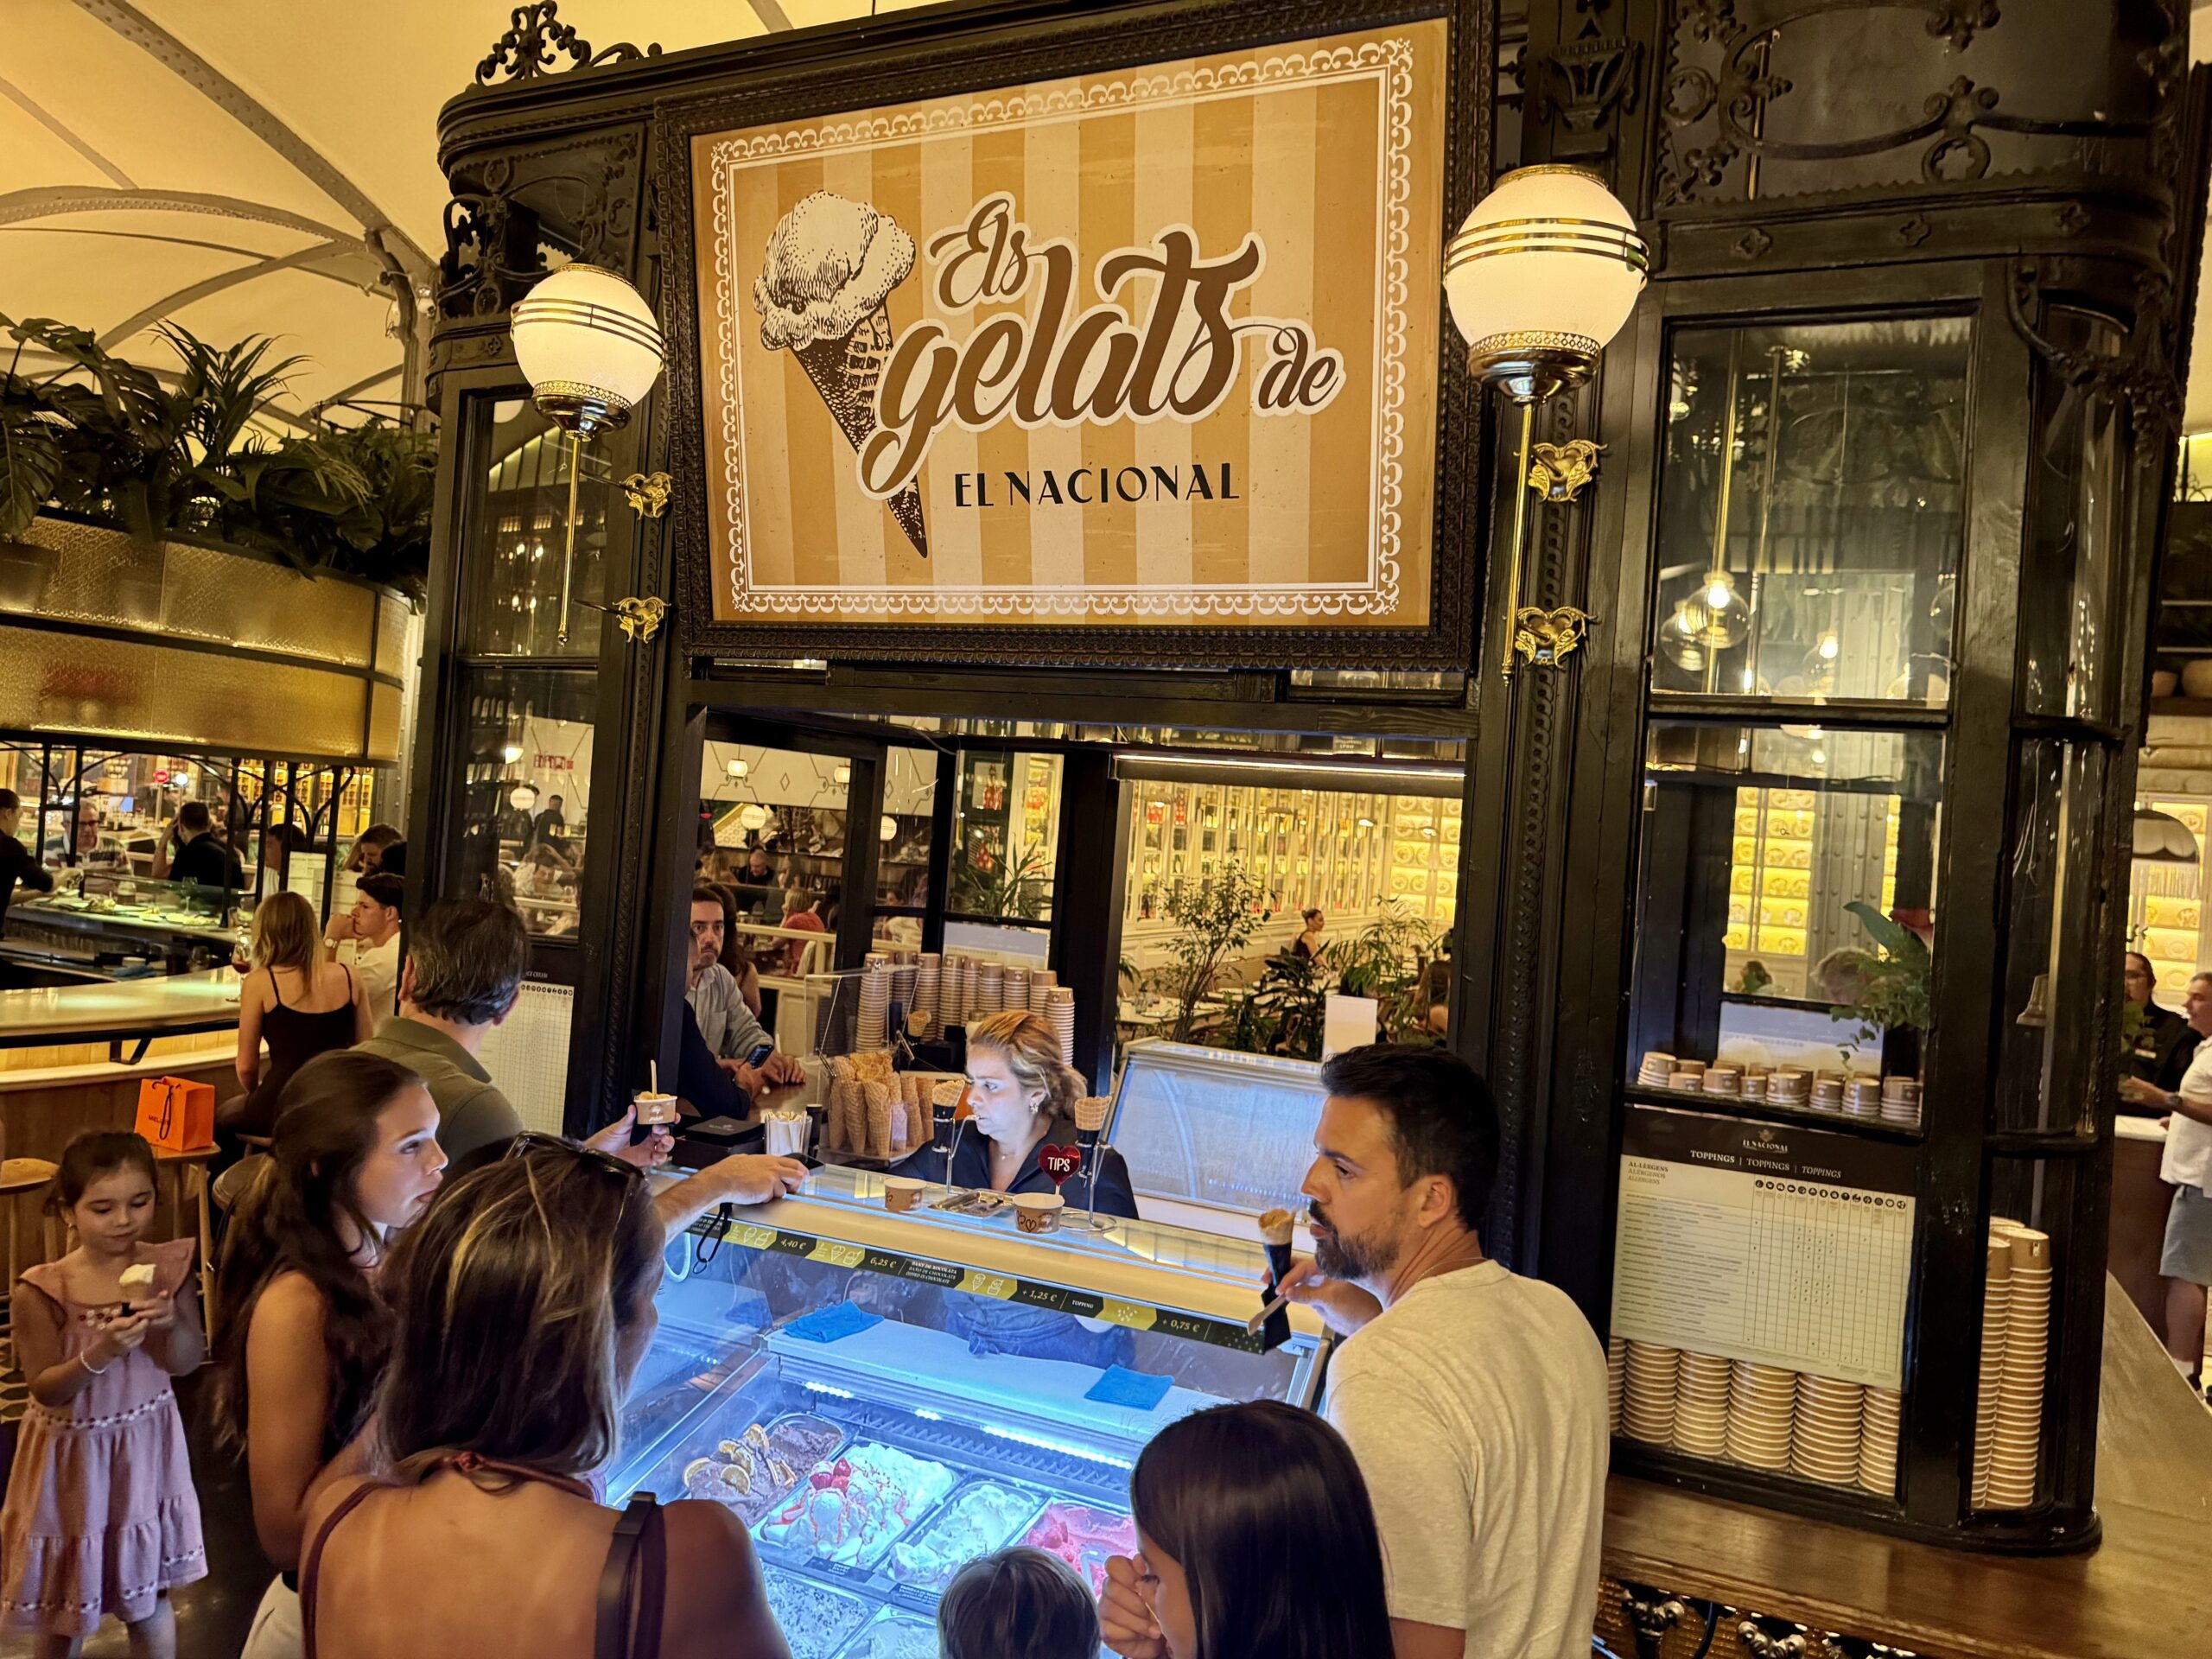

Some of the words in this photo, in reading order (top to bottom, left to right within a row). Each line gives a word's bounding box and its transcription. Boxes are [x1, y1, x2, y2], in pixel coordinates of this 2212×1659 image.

[930, 199, 1032, 309] Els
[861, 231, 1261, 493] gelats
[1259, 327, 1339, 409] de
[955, 473, 994, 508] EL
[1006, 461, 1240, 505] NACIONAL
[1751, 1141, 1788, 1153] NACIONAL
[1047, 1156, 1071, 1173] TIPS
[1690, 1150, 1735, 1163] TOPPINGS
[1746, 1158, 1789, 1171] TOPPINGS
[1802, 1166, 1842, 1179] TOPPINGS
[780, 1238, 798, 1249] 4,40
[799, 1242, 807, 1250] €
[870, 1256, 887, 1267] 6,25
[889, 1260, 897, 1268] €
[1029, 1289, 1049, 1300] 1,25
[1050, 1294, 1058, 1302] €
[1071, 1300, 1094, 1309] TOPPING
[1170, 1319, 1191, 1331] 0,75
[1192, 1324, 1200, 1332] €
